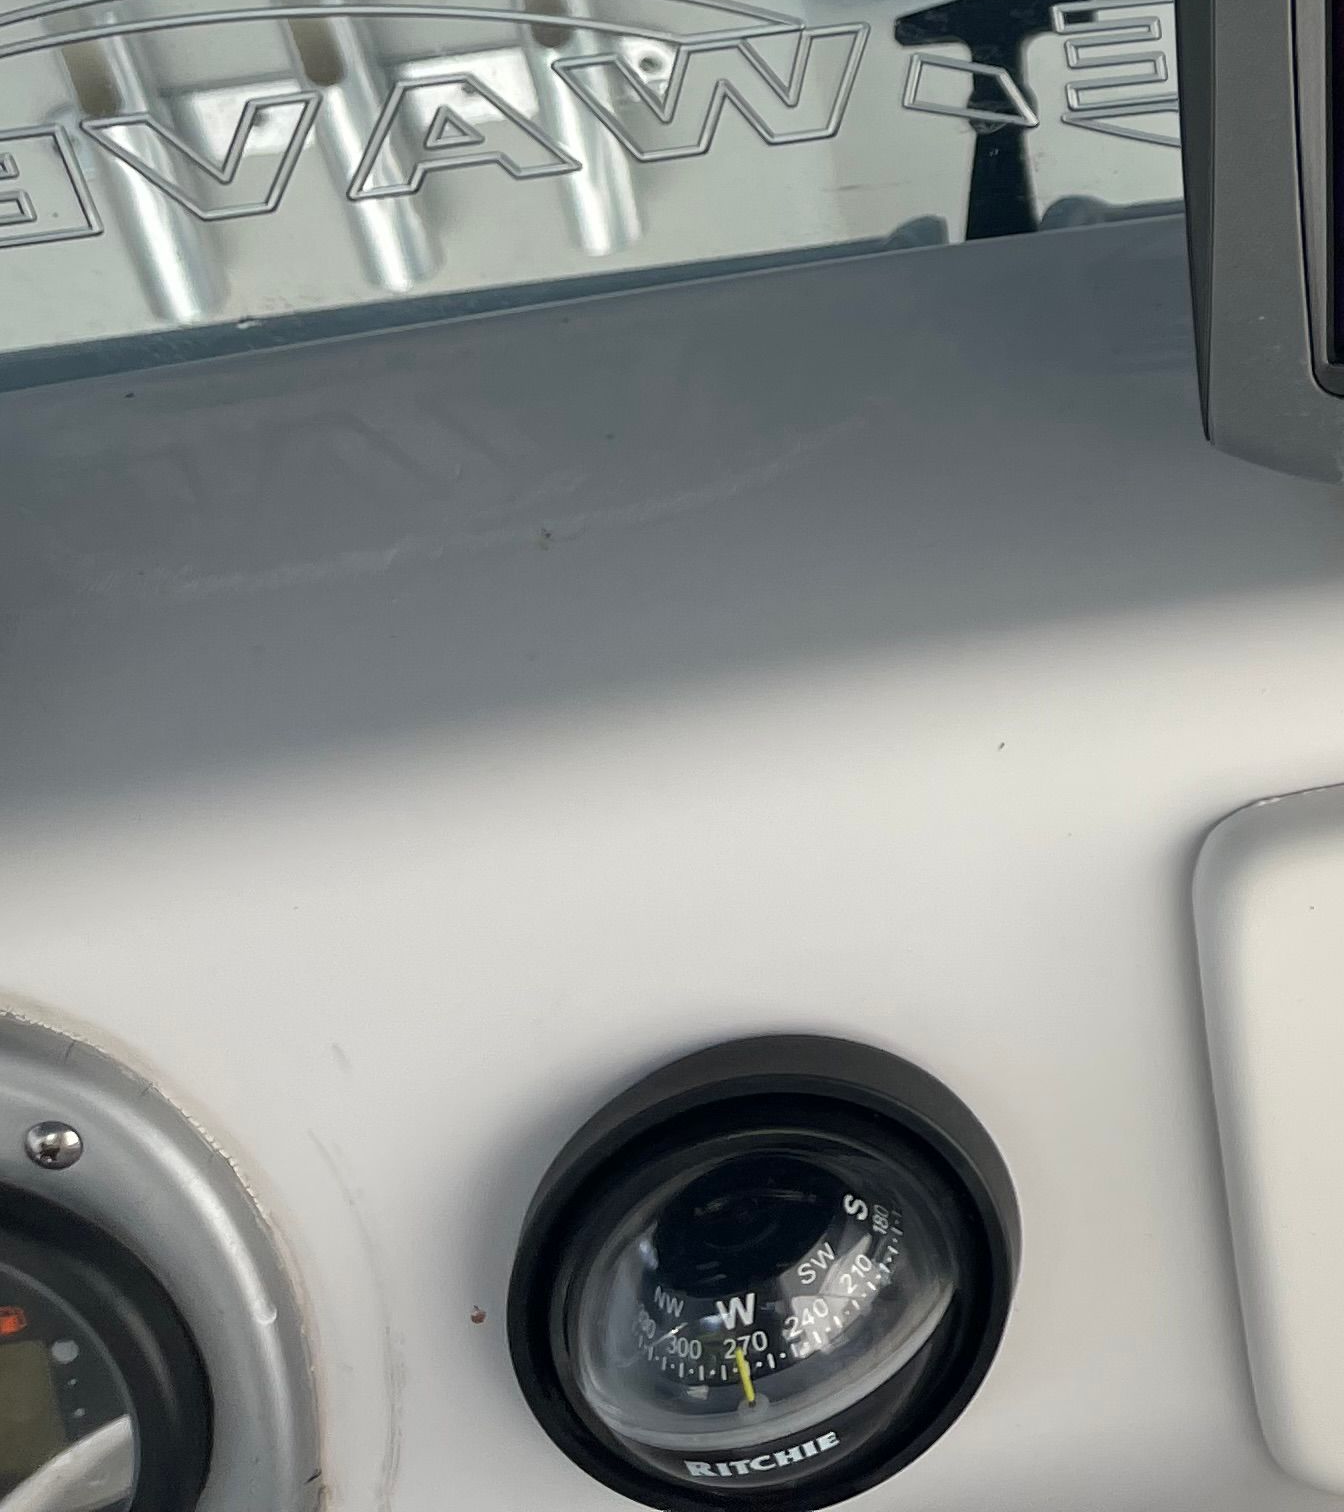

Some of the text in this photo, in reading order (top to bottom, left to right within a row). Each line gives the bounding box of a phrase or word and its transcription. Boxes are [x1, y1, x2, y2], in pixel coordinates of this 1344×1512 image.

[843, 1194, 868, 1221] S
[872, 1204, 889, 1235] 180
[797, 1242, 835, 1285] SW
[840, 1254, 873, 1294] 210
[654, 1286, 684, 1318] NW
[716, 1292, 756, 1330] W
[784, 1298, 829, 1339] 240
[723, 1330, 768, 1360] 270
[684, 1431, 840, 1477] RITCHIE
